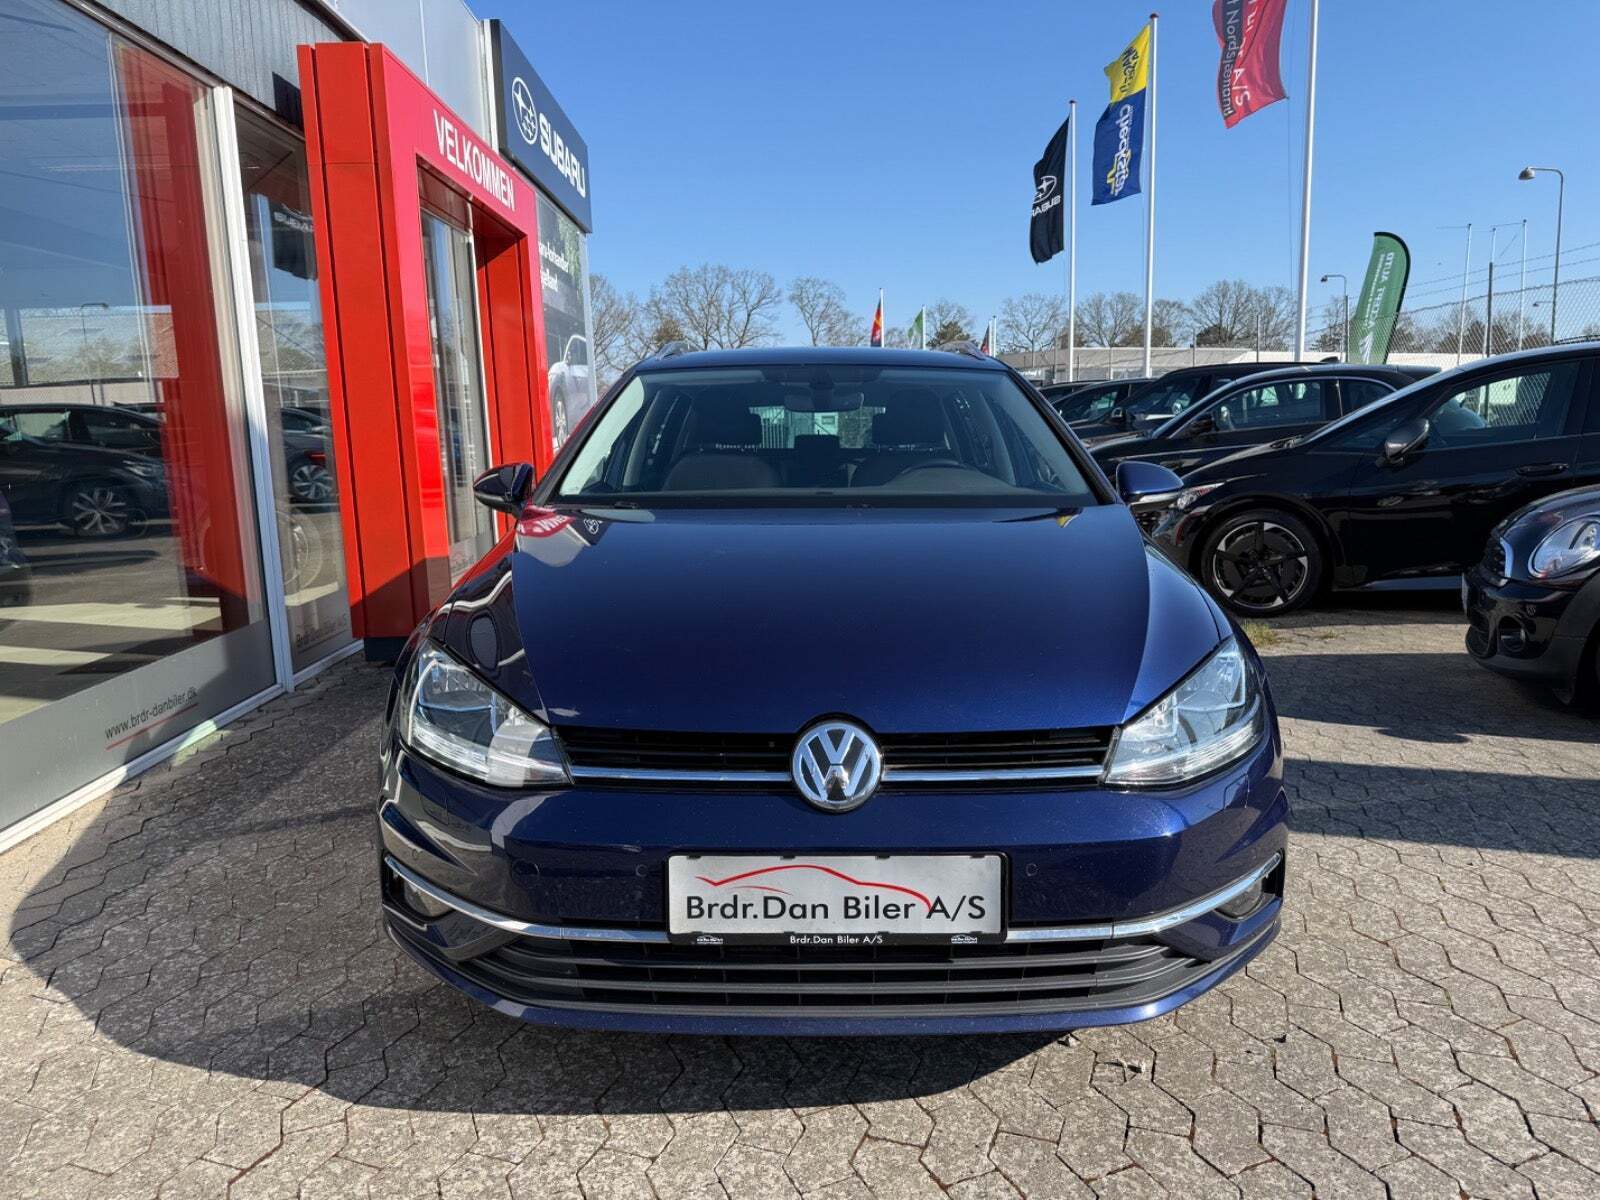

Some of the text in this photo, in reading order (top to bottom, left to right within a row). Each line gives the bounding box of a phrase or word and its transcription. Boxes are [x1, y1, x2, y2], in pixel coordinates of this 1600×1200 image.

[1232, 67, 1250, 106] A/S
[433, 109, 515, 212] VELKOMMEN
[539, 113, 586, 198] SUBARU
[686, 894, 986, 922] Brdr.Dan Biler A/S
[790, 934, 884, 944] Brdr.Dan Biler A/S
